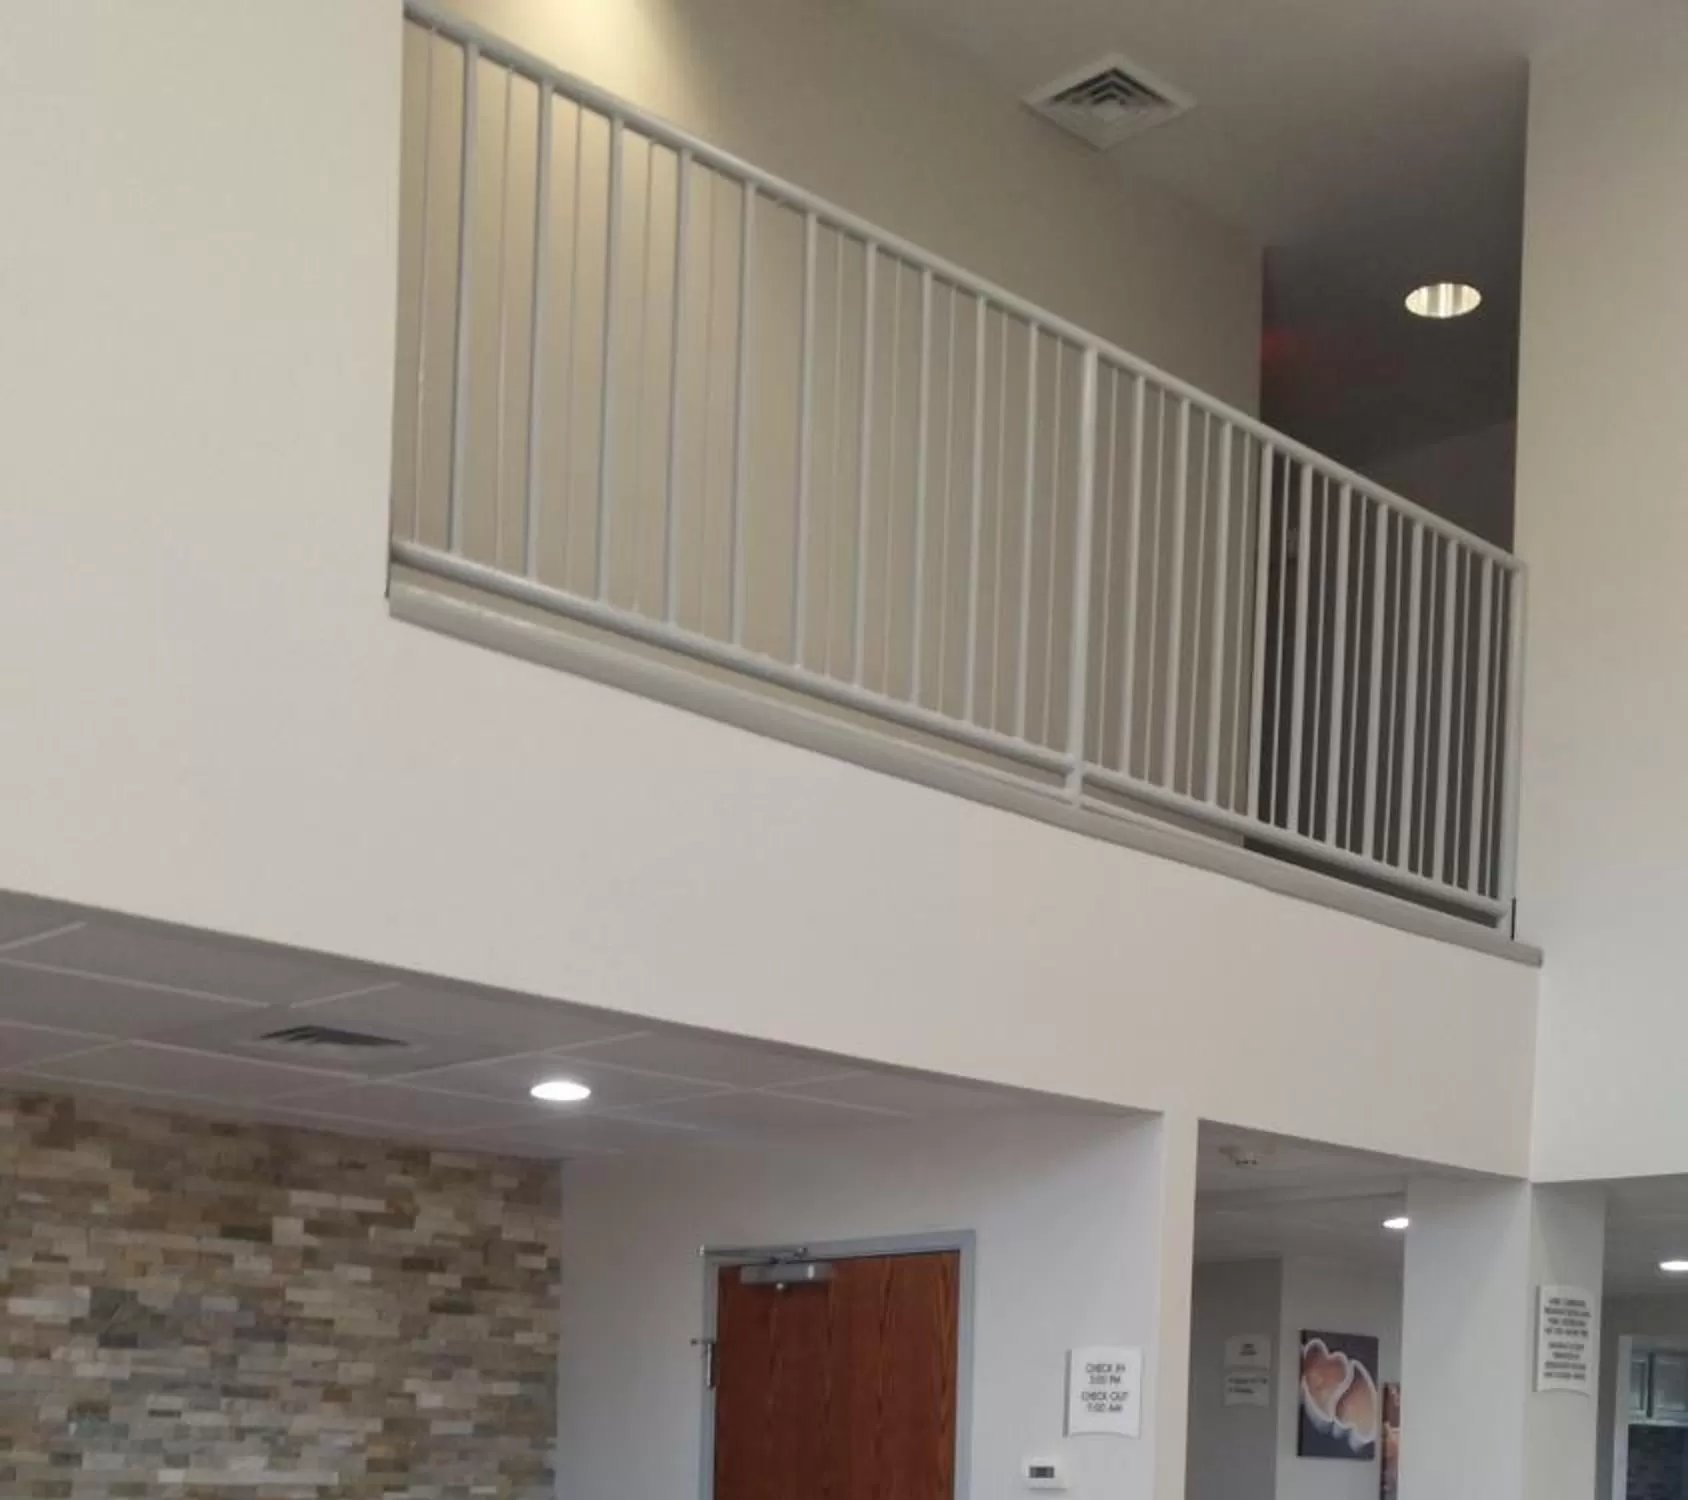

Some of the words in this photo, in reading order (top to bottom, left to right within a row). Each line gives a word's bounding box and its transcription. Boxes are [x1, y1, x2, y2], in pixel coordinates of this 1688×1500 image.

[1085, 1362, 1113, 1373] CHECK
[1108, 1374, 1122, 1385] PM
[1081, 1391, 1108, 1401] CHECK
[1108, 1391, 1129, 1401] OUT
